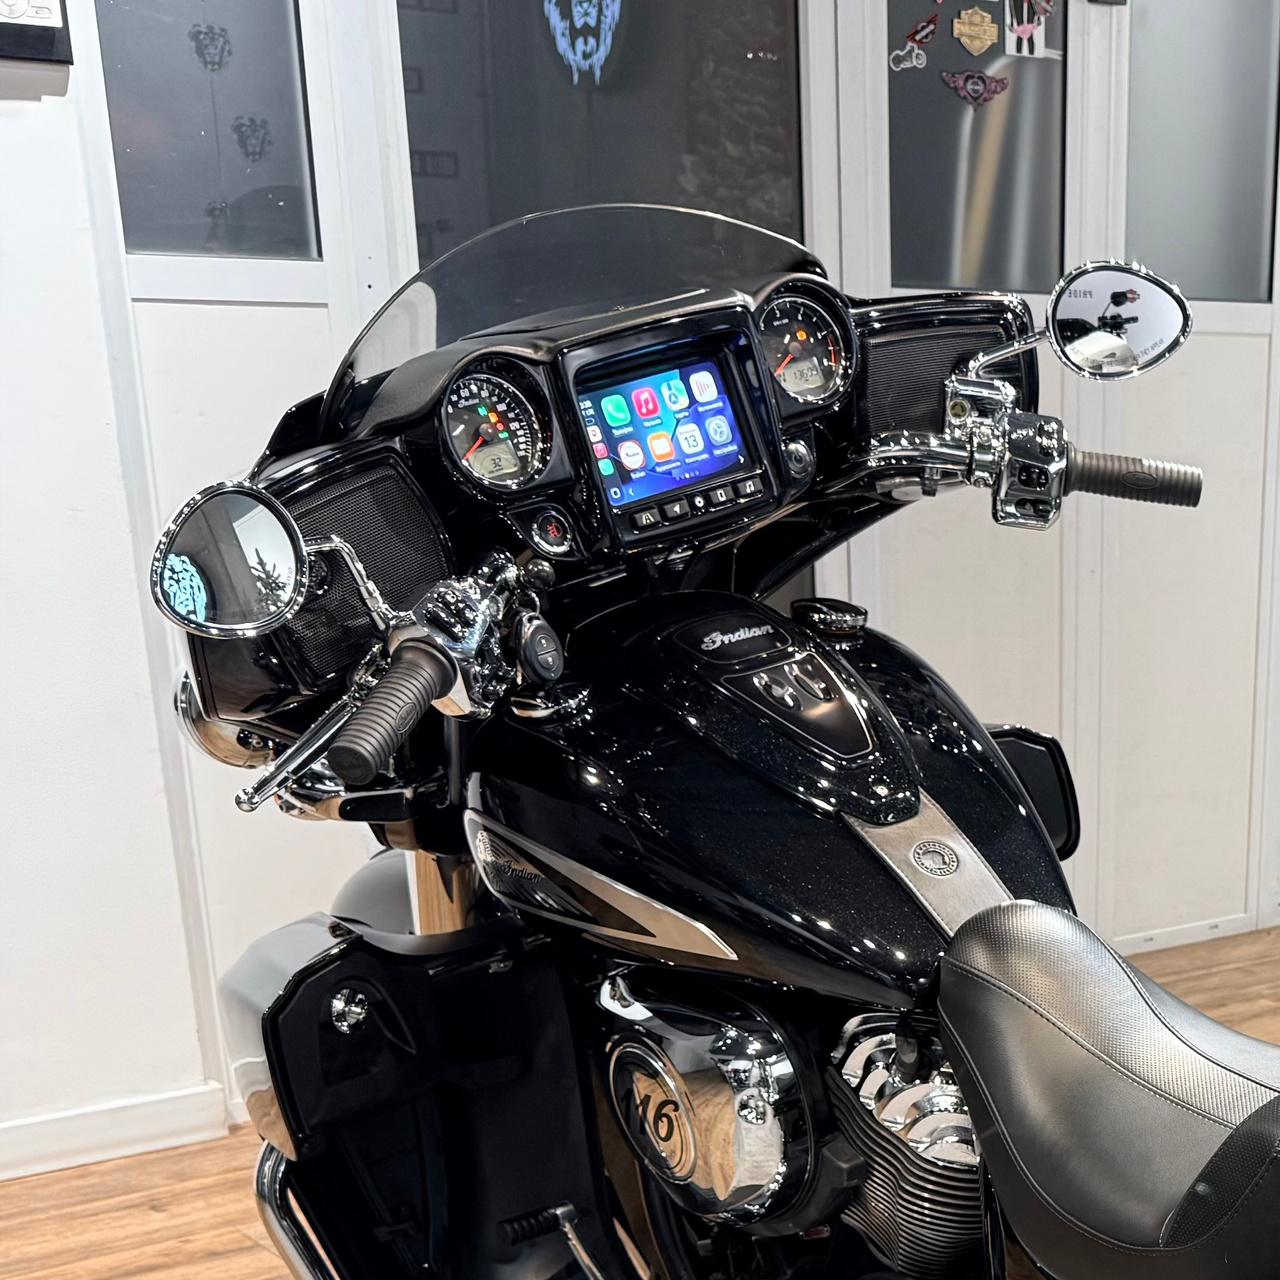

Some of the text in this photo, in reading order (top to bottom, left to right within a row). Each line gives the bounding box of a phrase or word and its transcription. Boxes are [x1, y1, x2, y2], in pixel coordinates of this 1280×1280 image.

[684, 435, 699, 449] 13
[491, 457, 502, 468] 32
[701, 625, 774, 650] Indian
[501, 860, 542, 884] Indian
